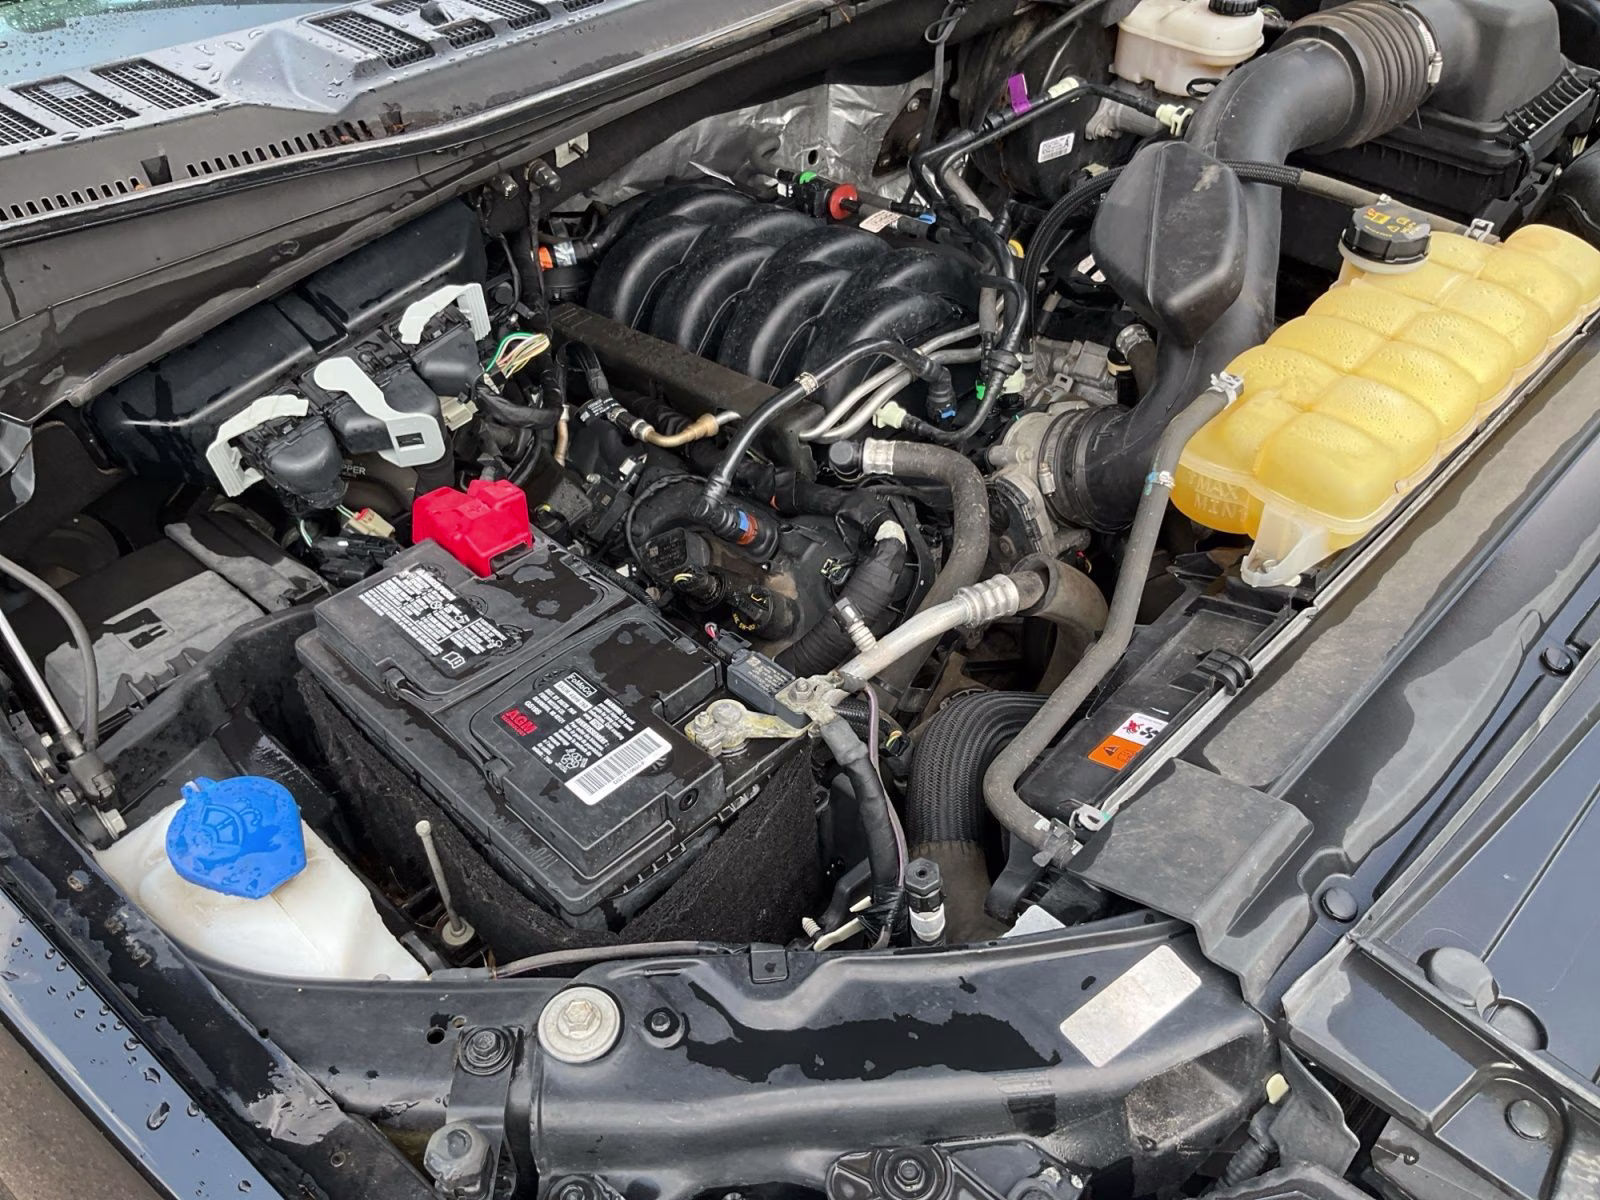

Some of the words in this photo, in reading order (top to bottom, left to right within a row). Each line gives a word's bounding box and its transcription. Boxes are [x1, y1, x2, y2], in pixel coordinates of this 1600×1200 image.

[1197, 475, 1239, 500] MAX
[1194, 493, 1237, 519] MIN
[567, 673, 593, 696] FoMoCo
[505, 708, 538, 735] AGM
